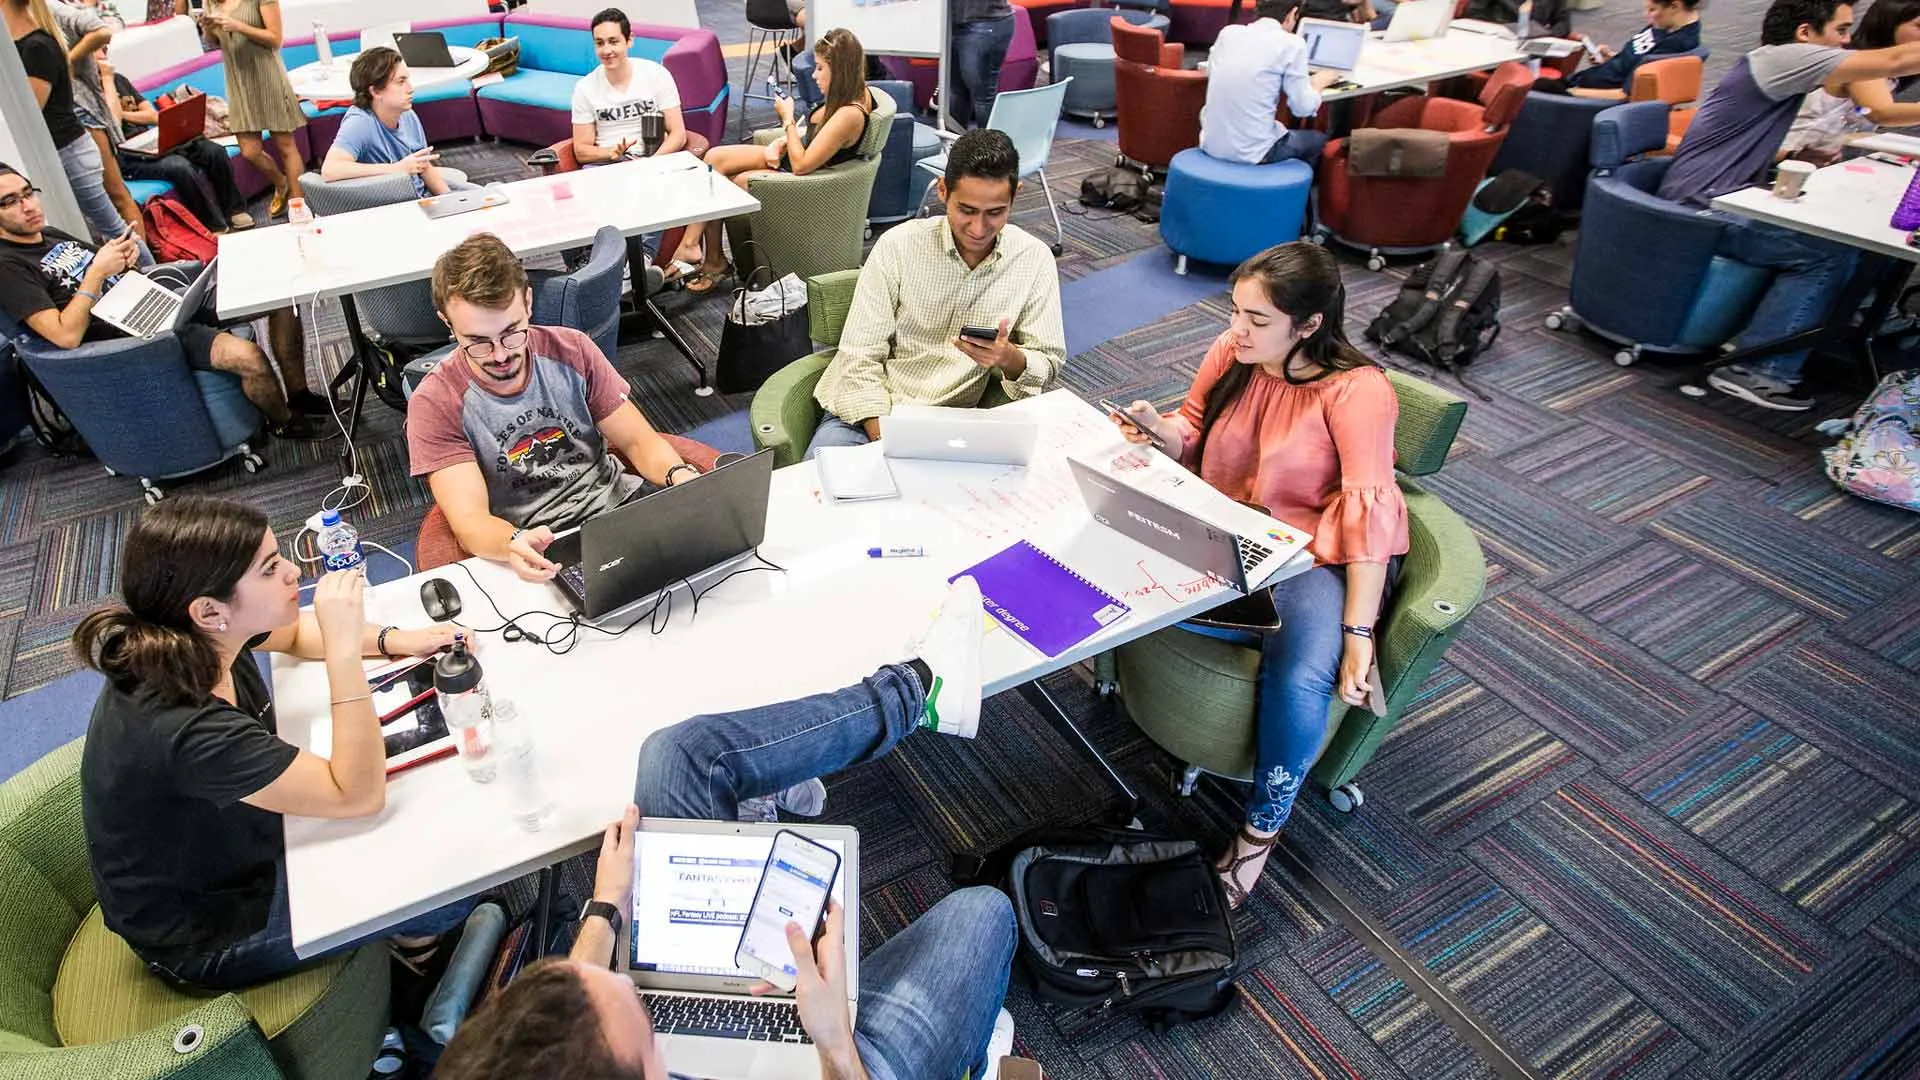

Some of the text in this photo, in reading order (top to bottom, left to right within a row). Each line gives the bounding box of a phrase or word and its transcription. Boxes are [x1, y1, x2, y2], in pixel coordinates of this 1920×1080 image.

[516, 410, 533, 426] OF
[599, 556, 624, 572] acer
[995, 607, 1031, 632] degree
